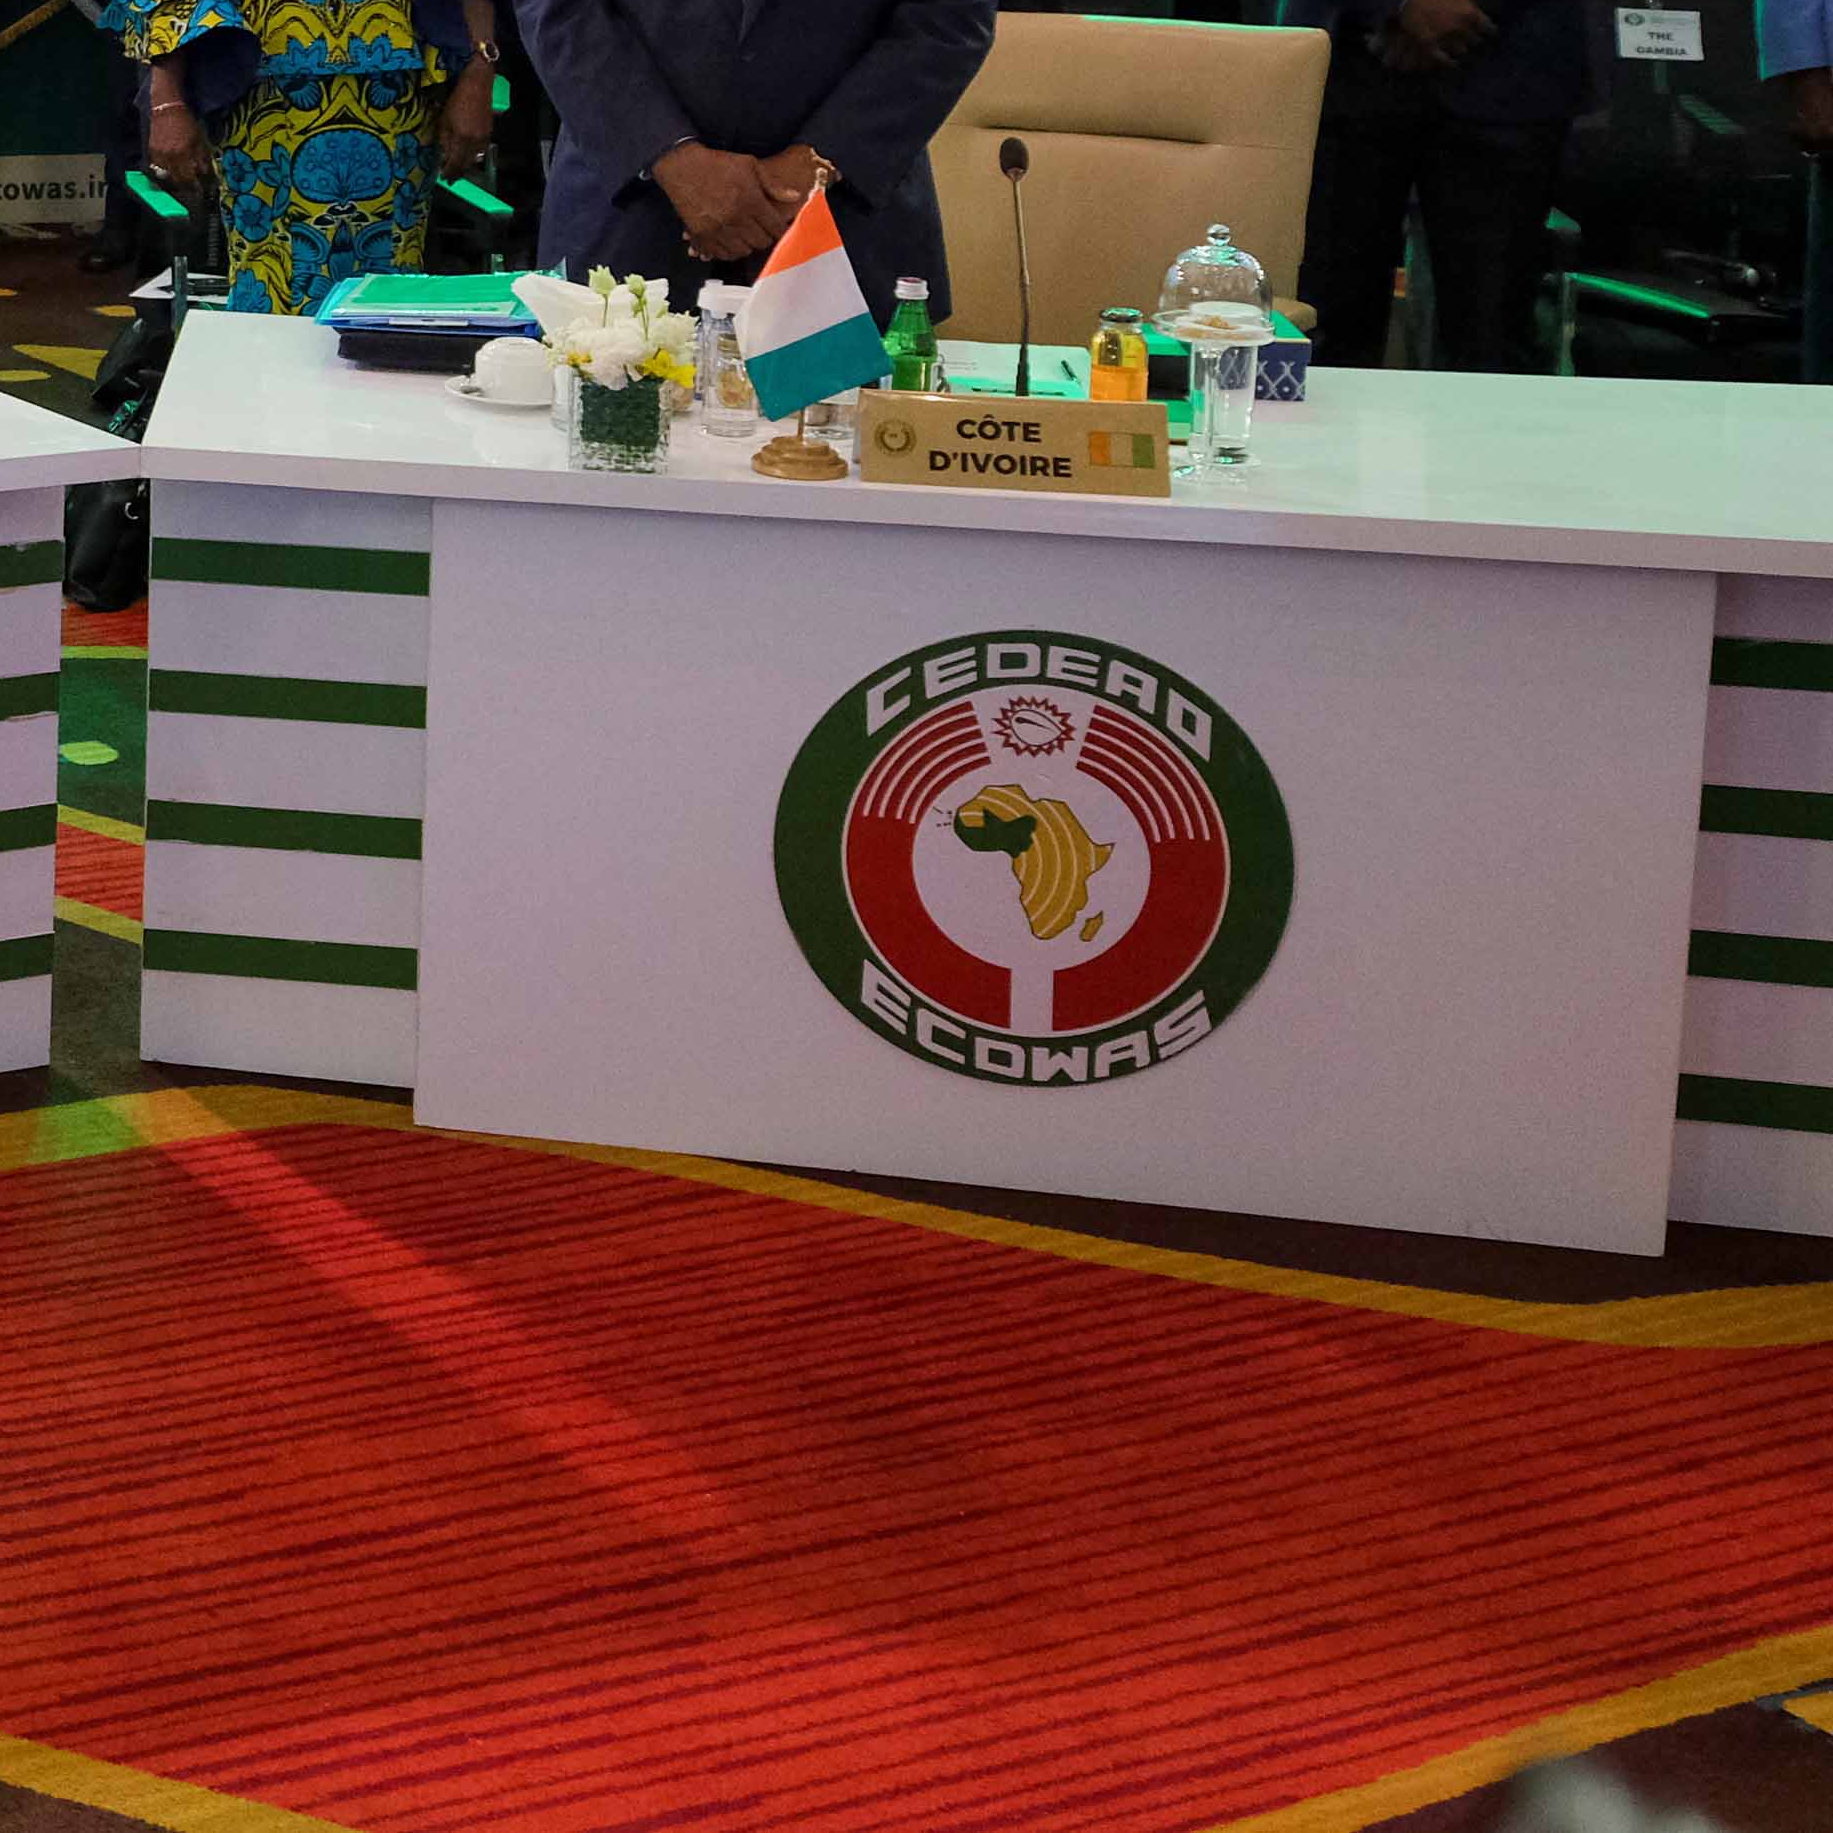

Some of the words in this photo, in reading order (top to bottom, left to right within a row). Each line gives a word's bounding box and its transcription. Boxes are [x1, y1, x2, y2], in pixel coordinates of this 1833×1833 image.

[929, 450, 1073, 478] D'IVOIRE
[956, 415, 1042, 443] CÔTE
[867, 643, 1212, 761] CEDEAO
[862, 960, 1212, 1082] ECOWAS
